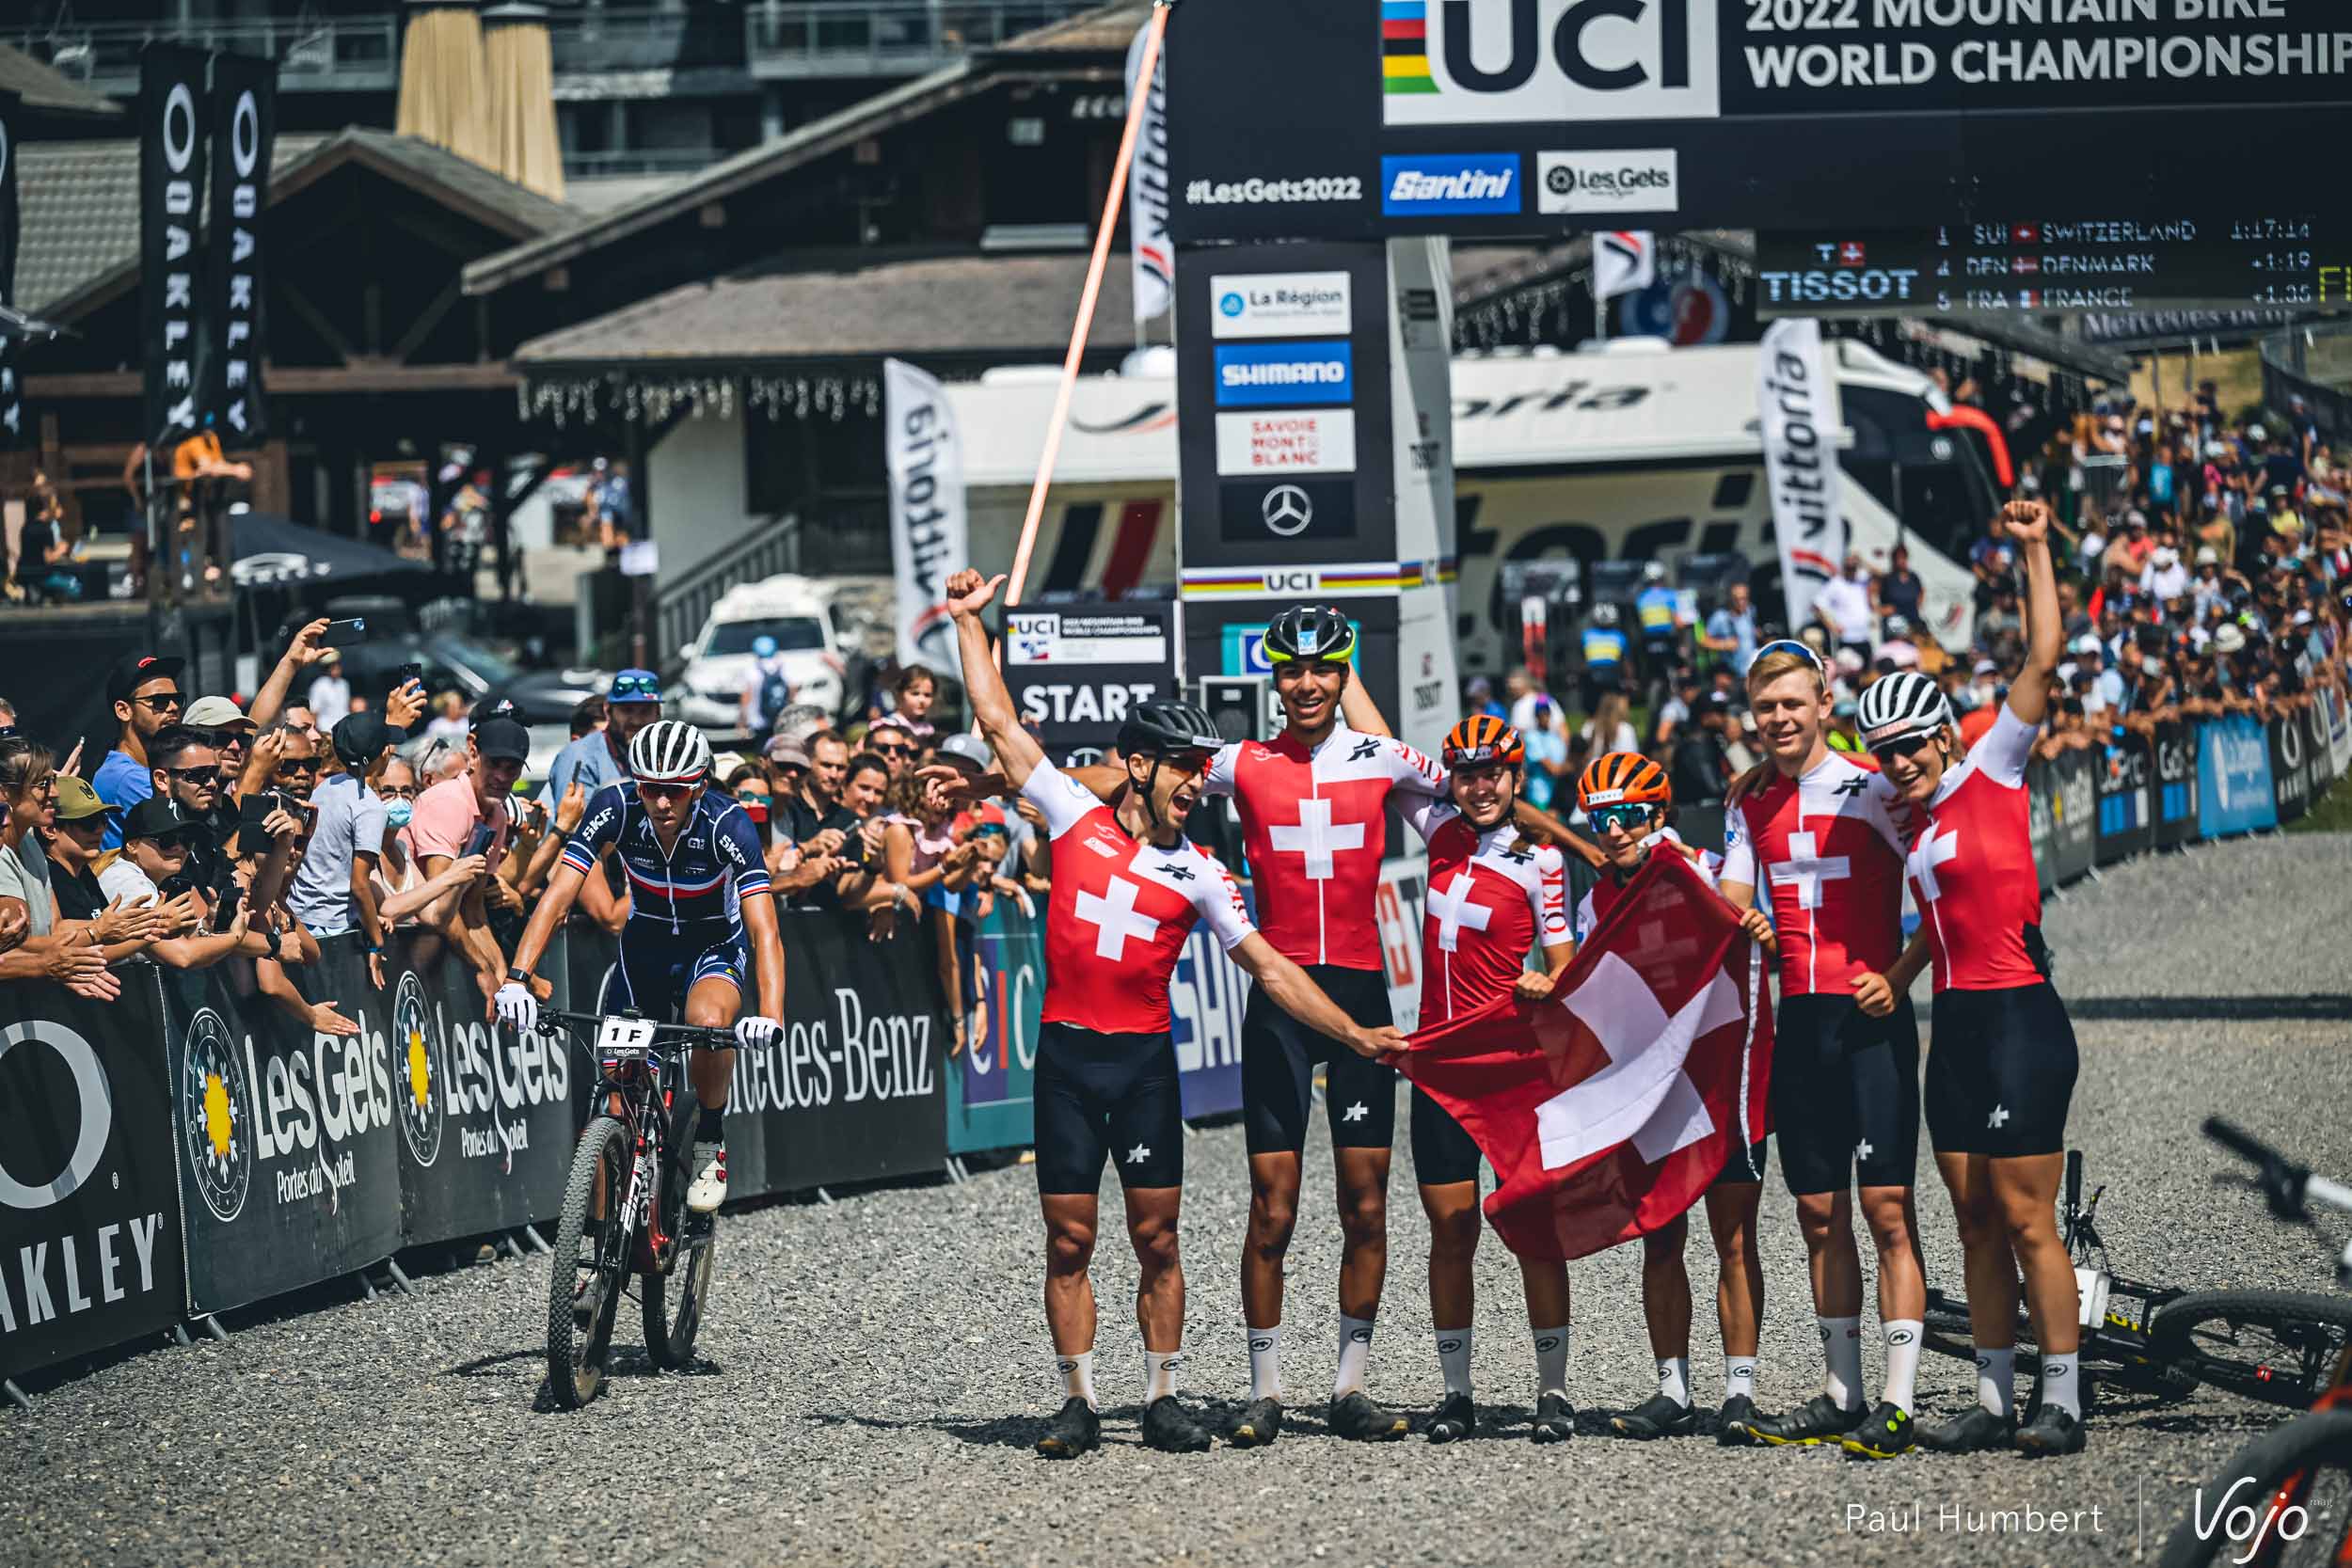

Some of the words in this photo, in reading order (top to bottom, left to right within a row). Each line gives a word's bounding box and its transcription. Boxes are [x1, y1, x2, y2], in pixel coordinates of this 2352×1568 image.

[1745, 0, 1860, 31] 2022
[1873, 0, 2158, 27] MOUNTAIN
[2174, 0, 2287, 20] BIKE
[1442, 0, 1691, 93] UCI
[1743, 41, 1937, 88] WORLD
[1185, 175, 1363, 204] #LesGets2022
[1389, 168, 1514, 202] Santini
[1580, 169, 1616, 191] Les
[1617, 166, 1670, 190] Gets
[1974, 223, 2009, 245] SUI
[2042, 219, 2197, 244] SWITZERLAND
[2042, 253, 2155, 274] DENMARK
[1248, 290, 1273, 308] La
[1275, 288, 1344, 309] Région
[1759, 269, 1919, 302] TISSOT
[2042, 286, 2135, 309] FRANCE
[164, 180, 196, 429] OAKLEY
[227, 183, 257, 433] OAKLEY
[1221, 361, 1345, 387] SHIMANO
[1251, 418, 1317, 434] SAVOIE
[1251, 452, 1318, 467] BLANC
[1779, 349, 1830, 542] vittoria
[1266, 572, 1313, 592] UCI
[1017, 619, 1055, 635] UCI
[1021, 684, 1156, 723] START
[581, 806, 615, 842] SKF
[718, 833, 747, 866] SKF
[1539, 867, 1567, 935] ÖKK
[611, 1026, 620, 1042] 1
[628, 1028, 643, 1043] F
[436, 1000, 495, 1117] Les
[491, 1016, 569, 1110] Gets
[245, 1035, 318, 1160] Les
[313, 1008, 392, 1142] Gets
[460, 1123, 487, 1159] Portes
[276, 1165, 309, 1205] Portes
[310, 1160, 324, 1196] du
[318, 1132, 357, 1216] Soleil
